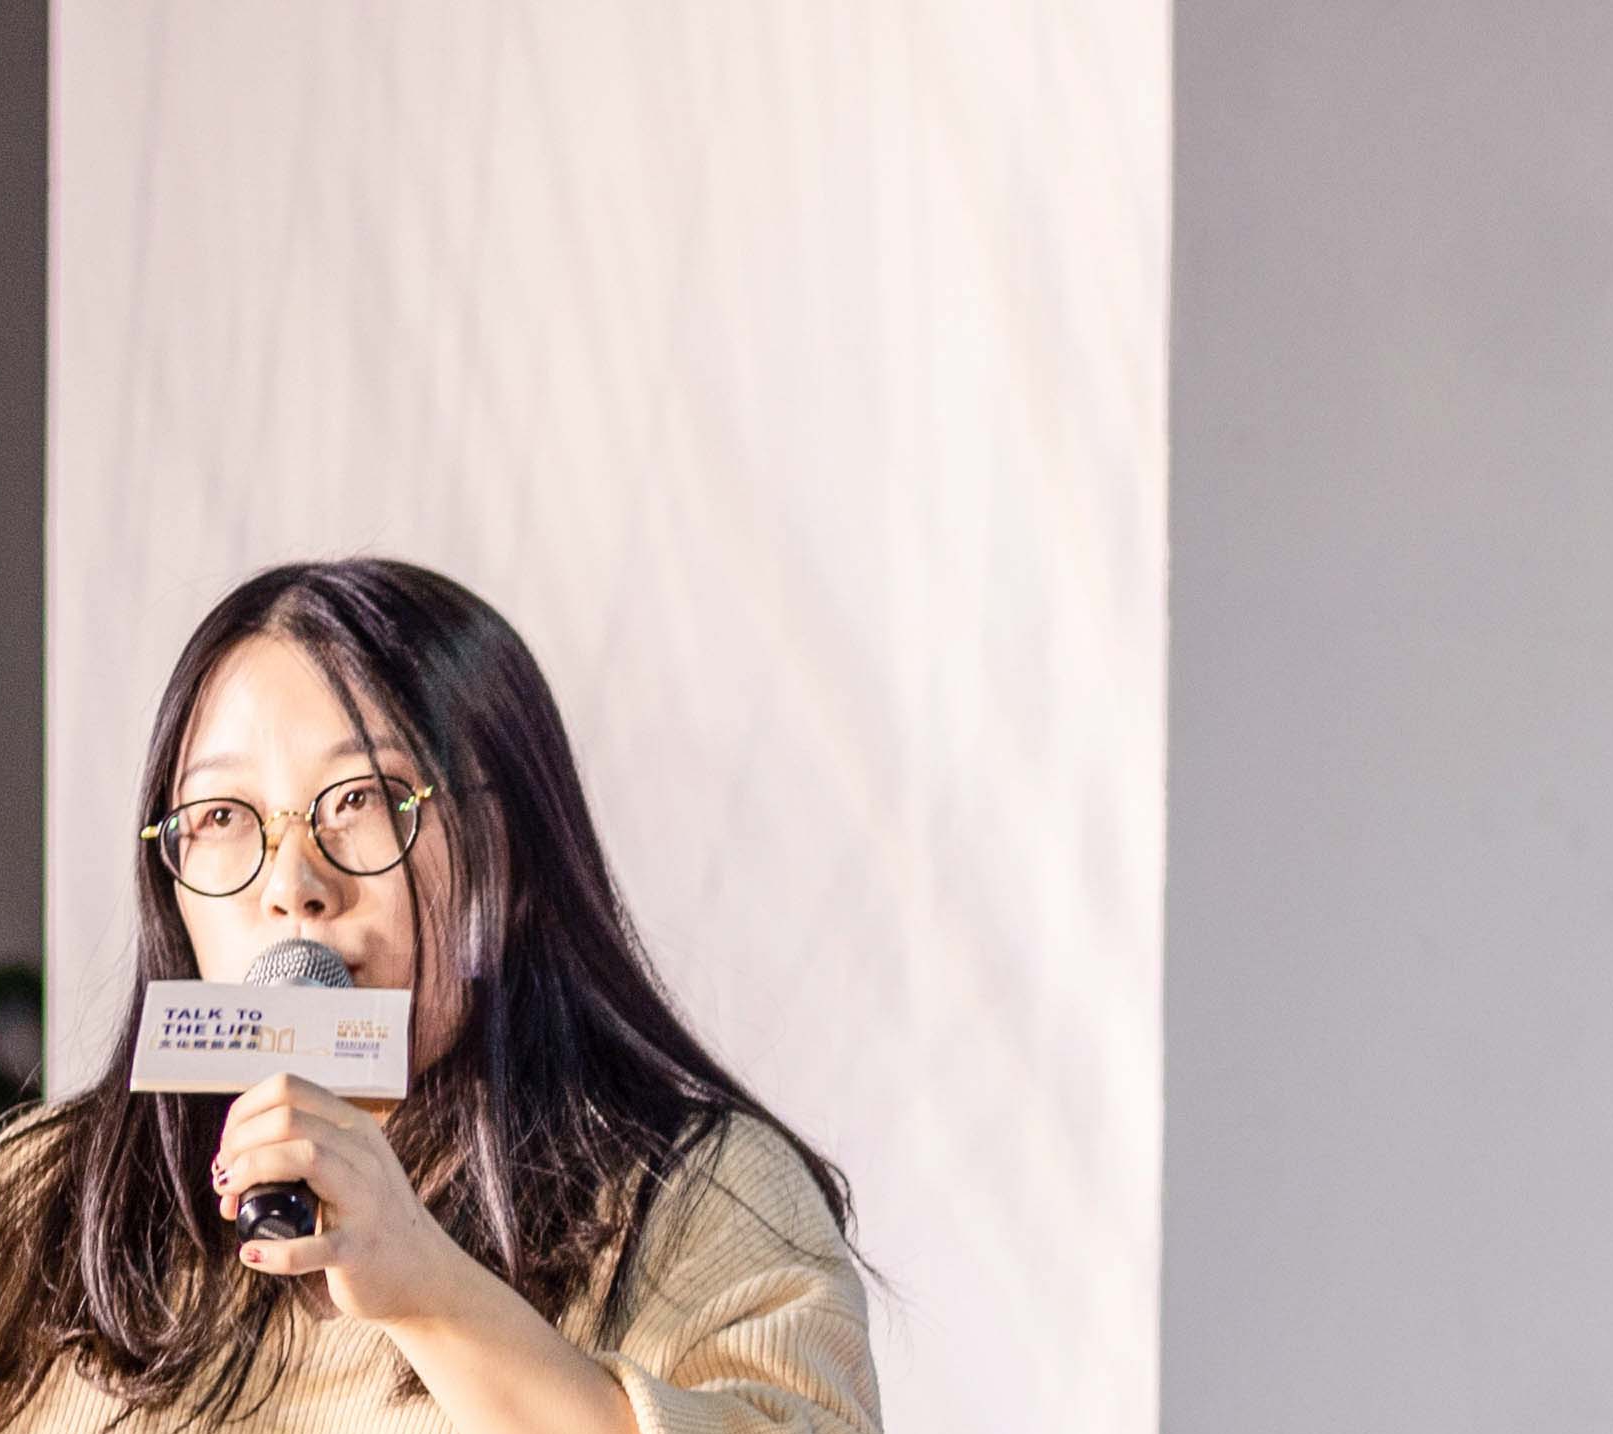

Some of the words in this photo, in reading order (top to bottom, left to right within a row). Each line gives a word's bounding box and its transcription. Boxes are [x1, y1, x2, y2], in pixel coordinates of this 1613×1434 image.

[164, 1007, 223, 1021] TALK
[236, 1008, 263, 1021] TO
[162, 1023, 207, 1036] THE
[215, 1023, 260, 1036] LIFE
